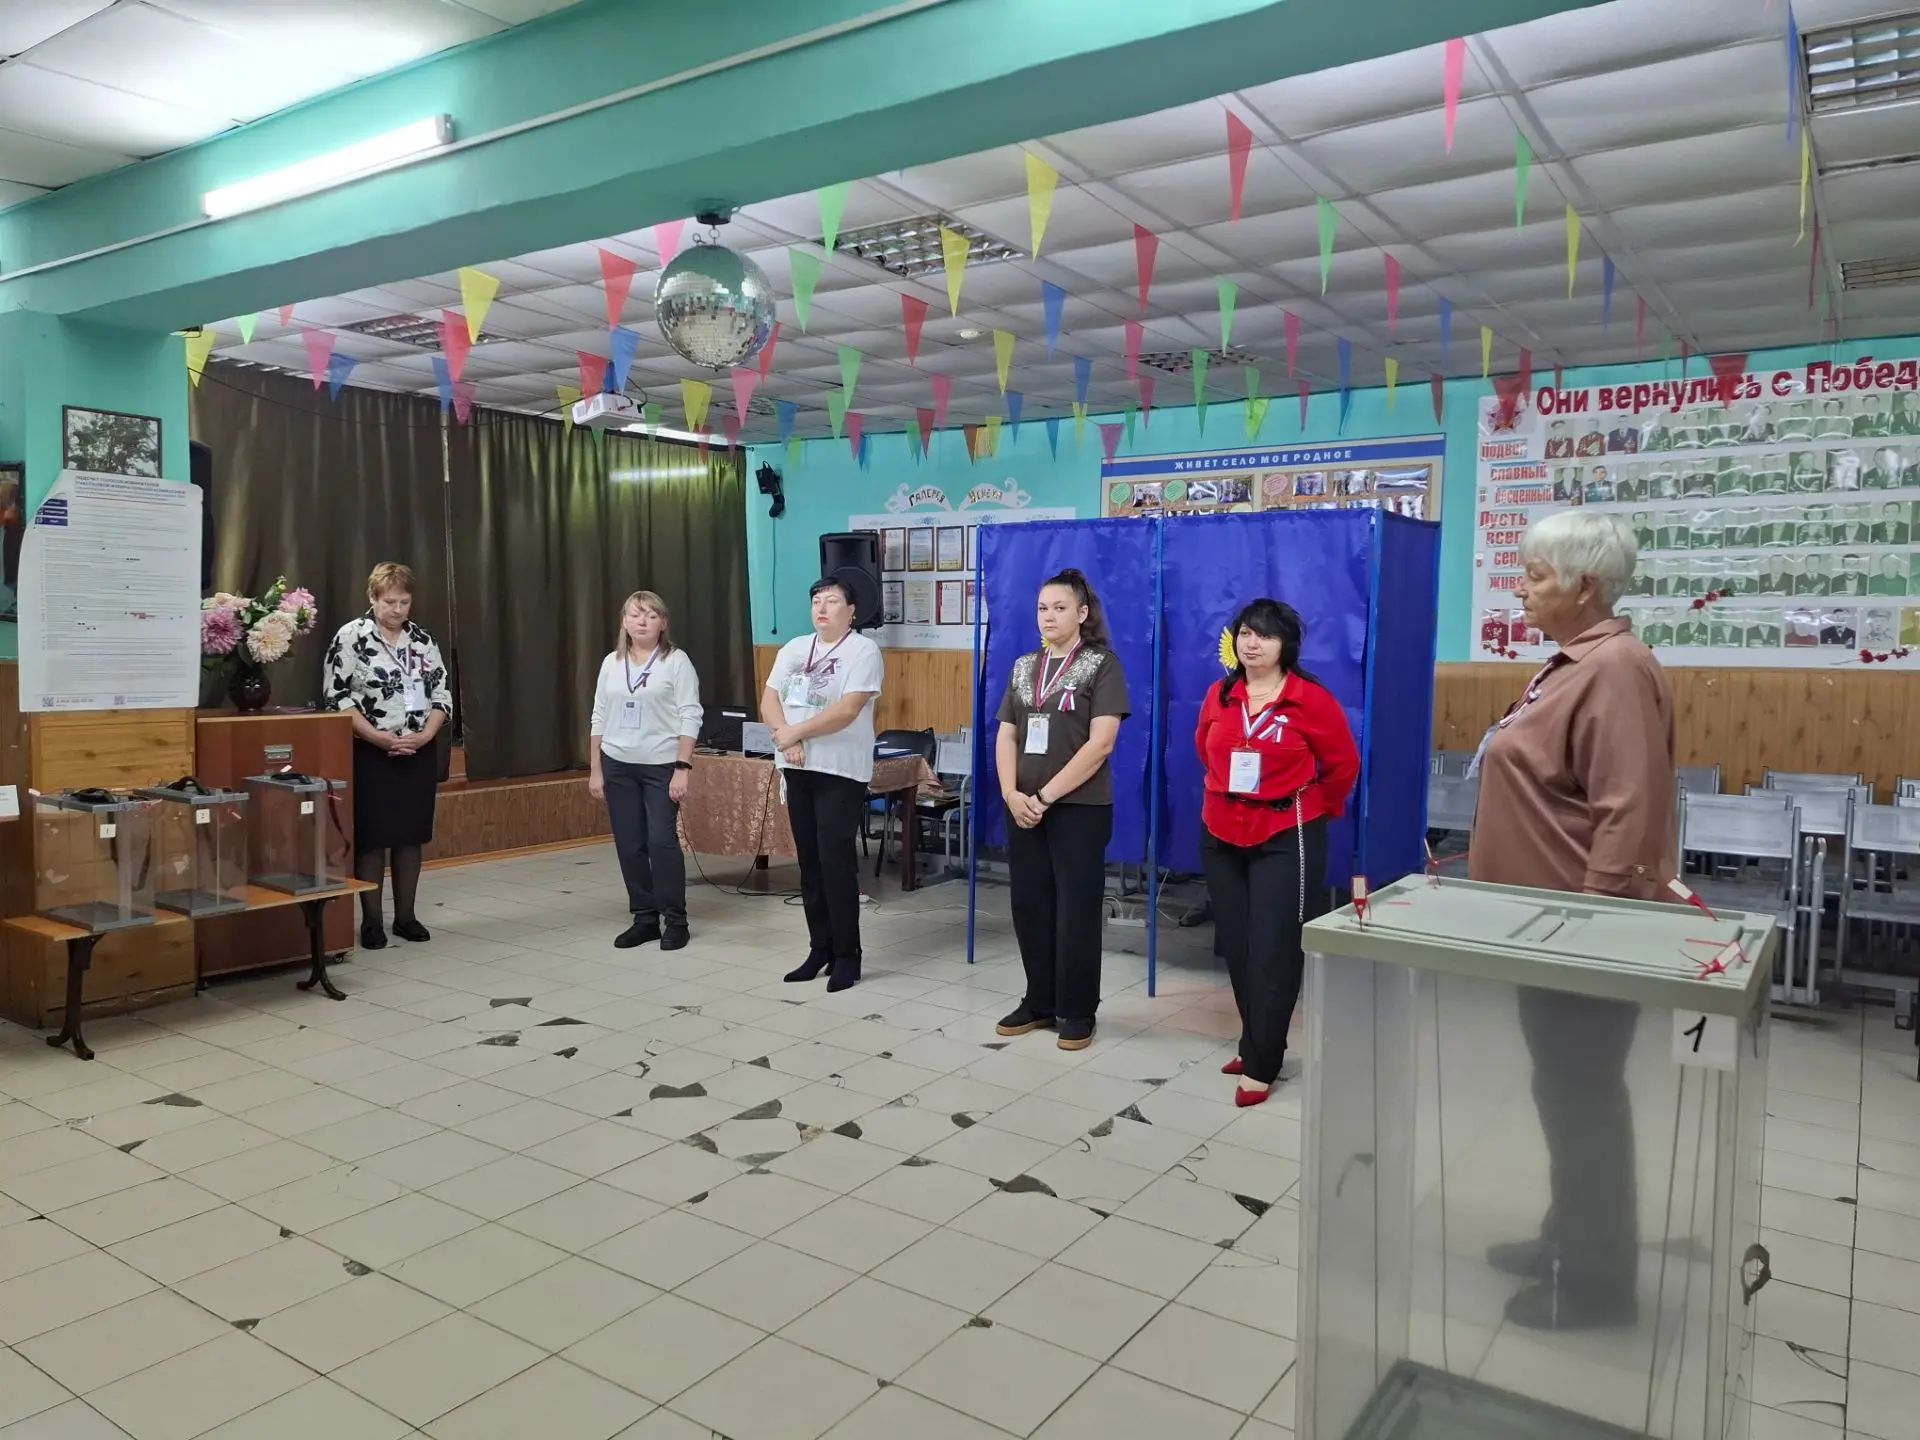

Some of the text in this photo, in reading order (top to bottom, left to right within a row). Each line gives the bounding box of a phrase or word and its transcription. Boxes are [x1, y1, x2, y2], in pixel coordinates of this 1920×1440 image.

[1537, 355, 1920, 416] Они вернулись с Побед
[1174, 449, 1352, 470] ЖИВЕТ СЕЛО МОЕ РОДНОЕ
[1479, 510, 1528, 529] Пусть
[1486, 530, 1524, 545] всег
[1493, 551, 1522, 568] сер
[1683, 1015, 1707, 1053] 1
